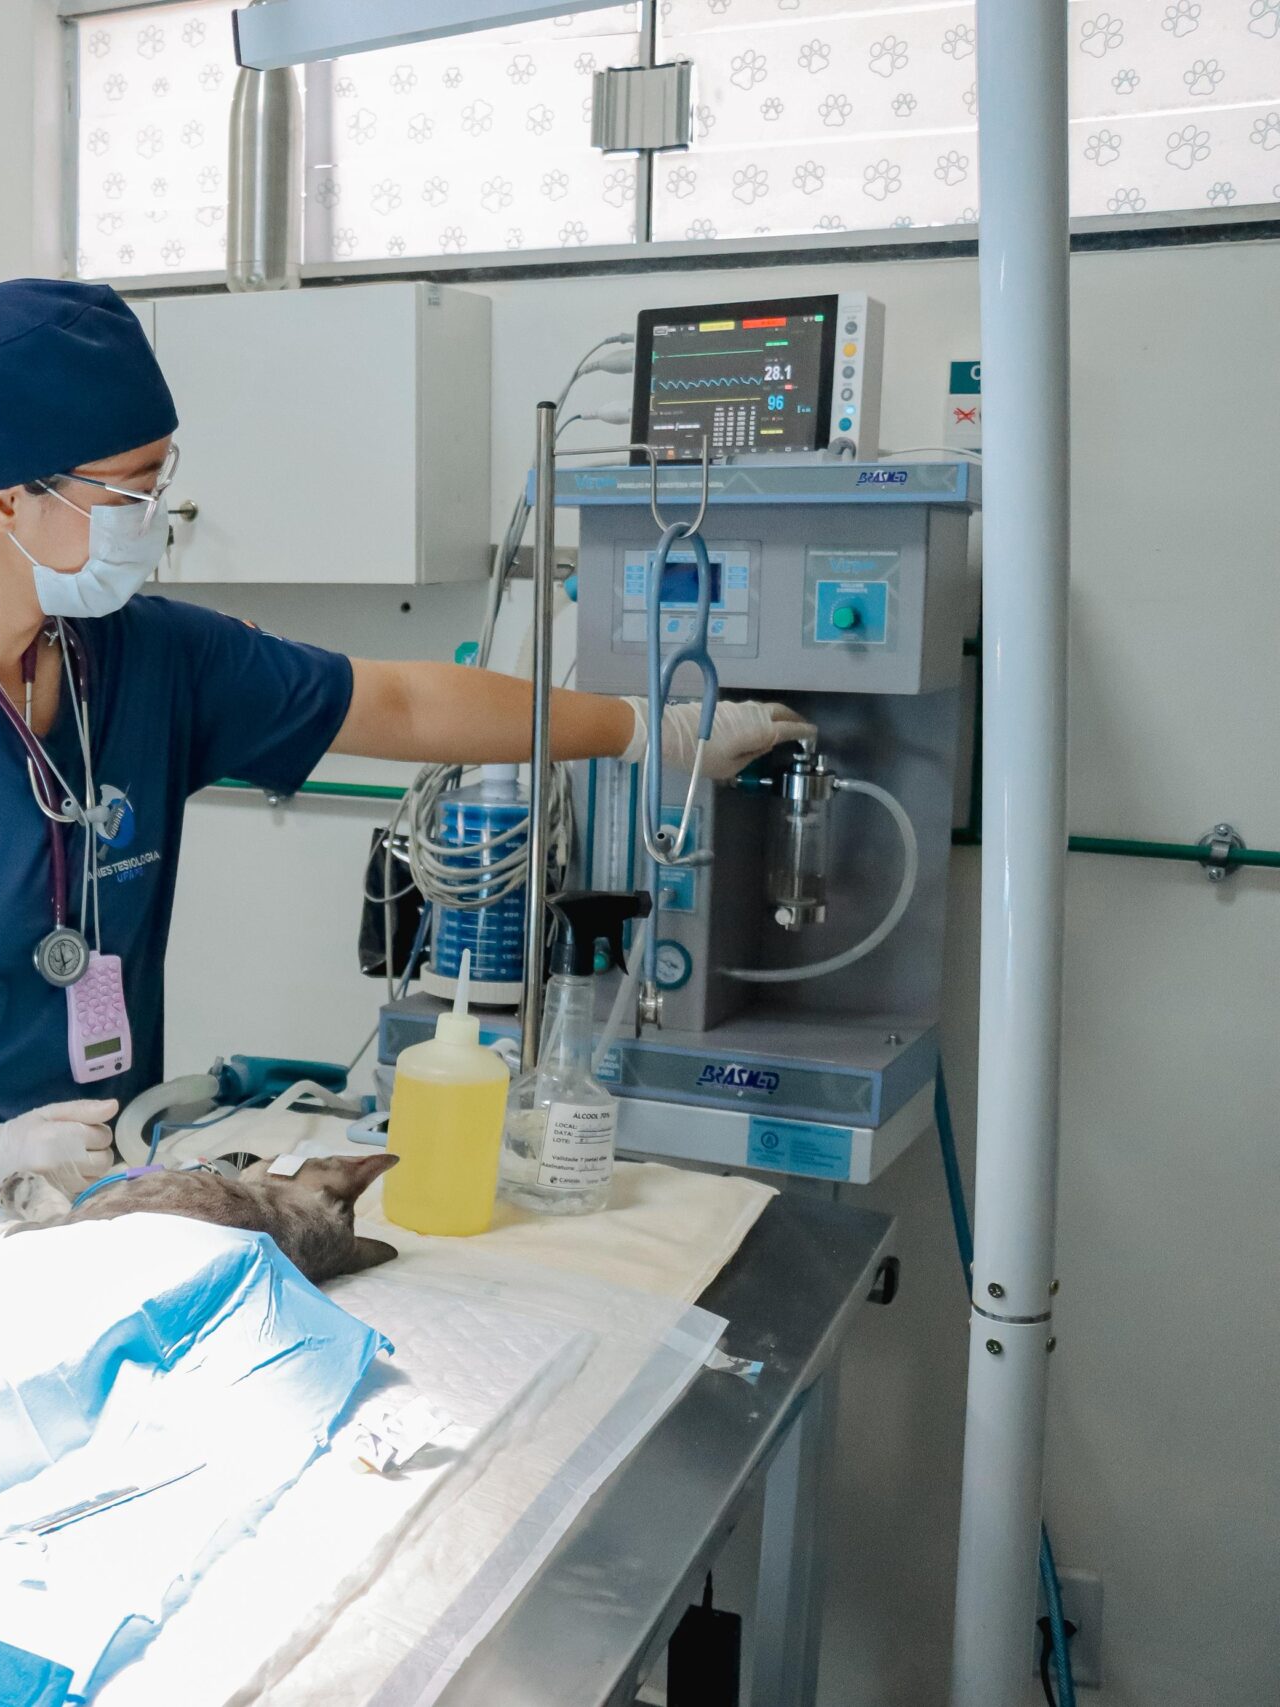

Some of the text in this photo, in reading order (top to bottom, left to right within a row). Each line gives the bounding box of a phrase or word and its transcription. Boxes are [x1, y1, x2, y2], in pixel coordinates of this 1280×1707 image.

[764, 365, 792, 381] 28.1
[767, 395, 784, 411] 96
[696, 1064, 780, 1094] BRASMED
